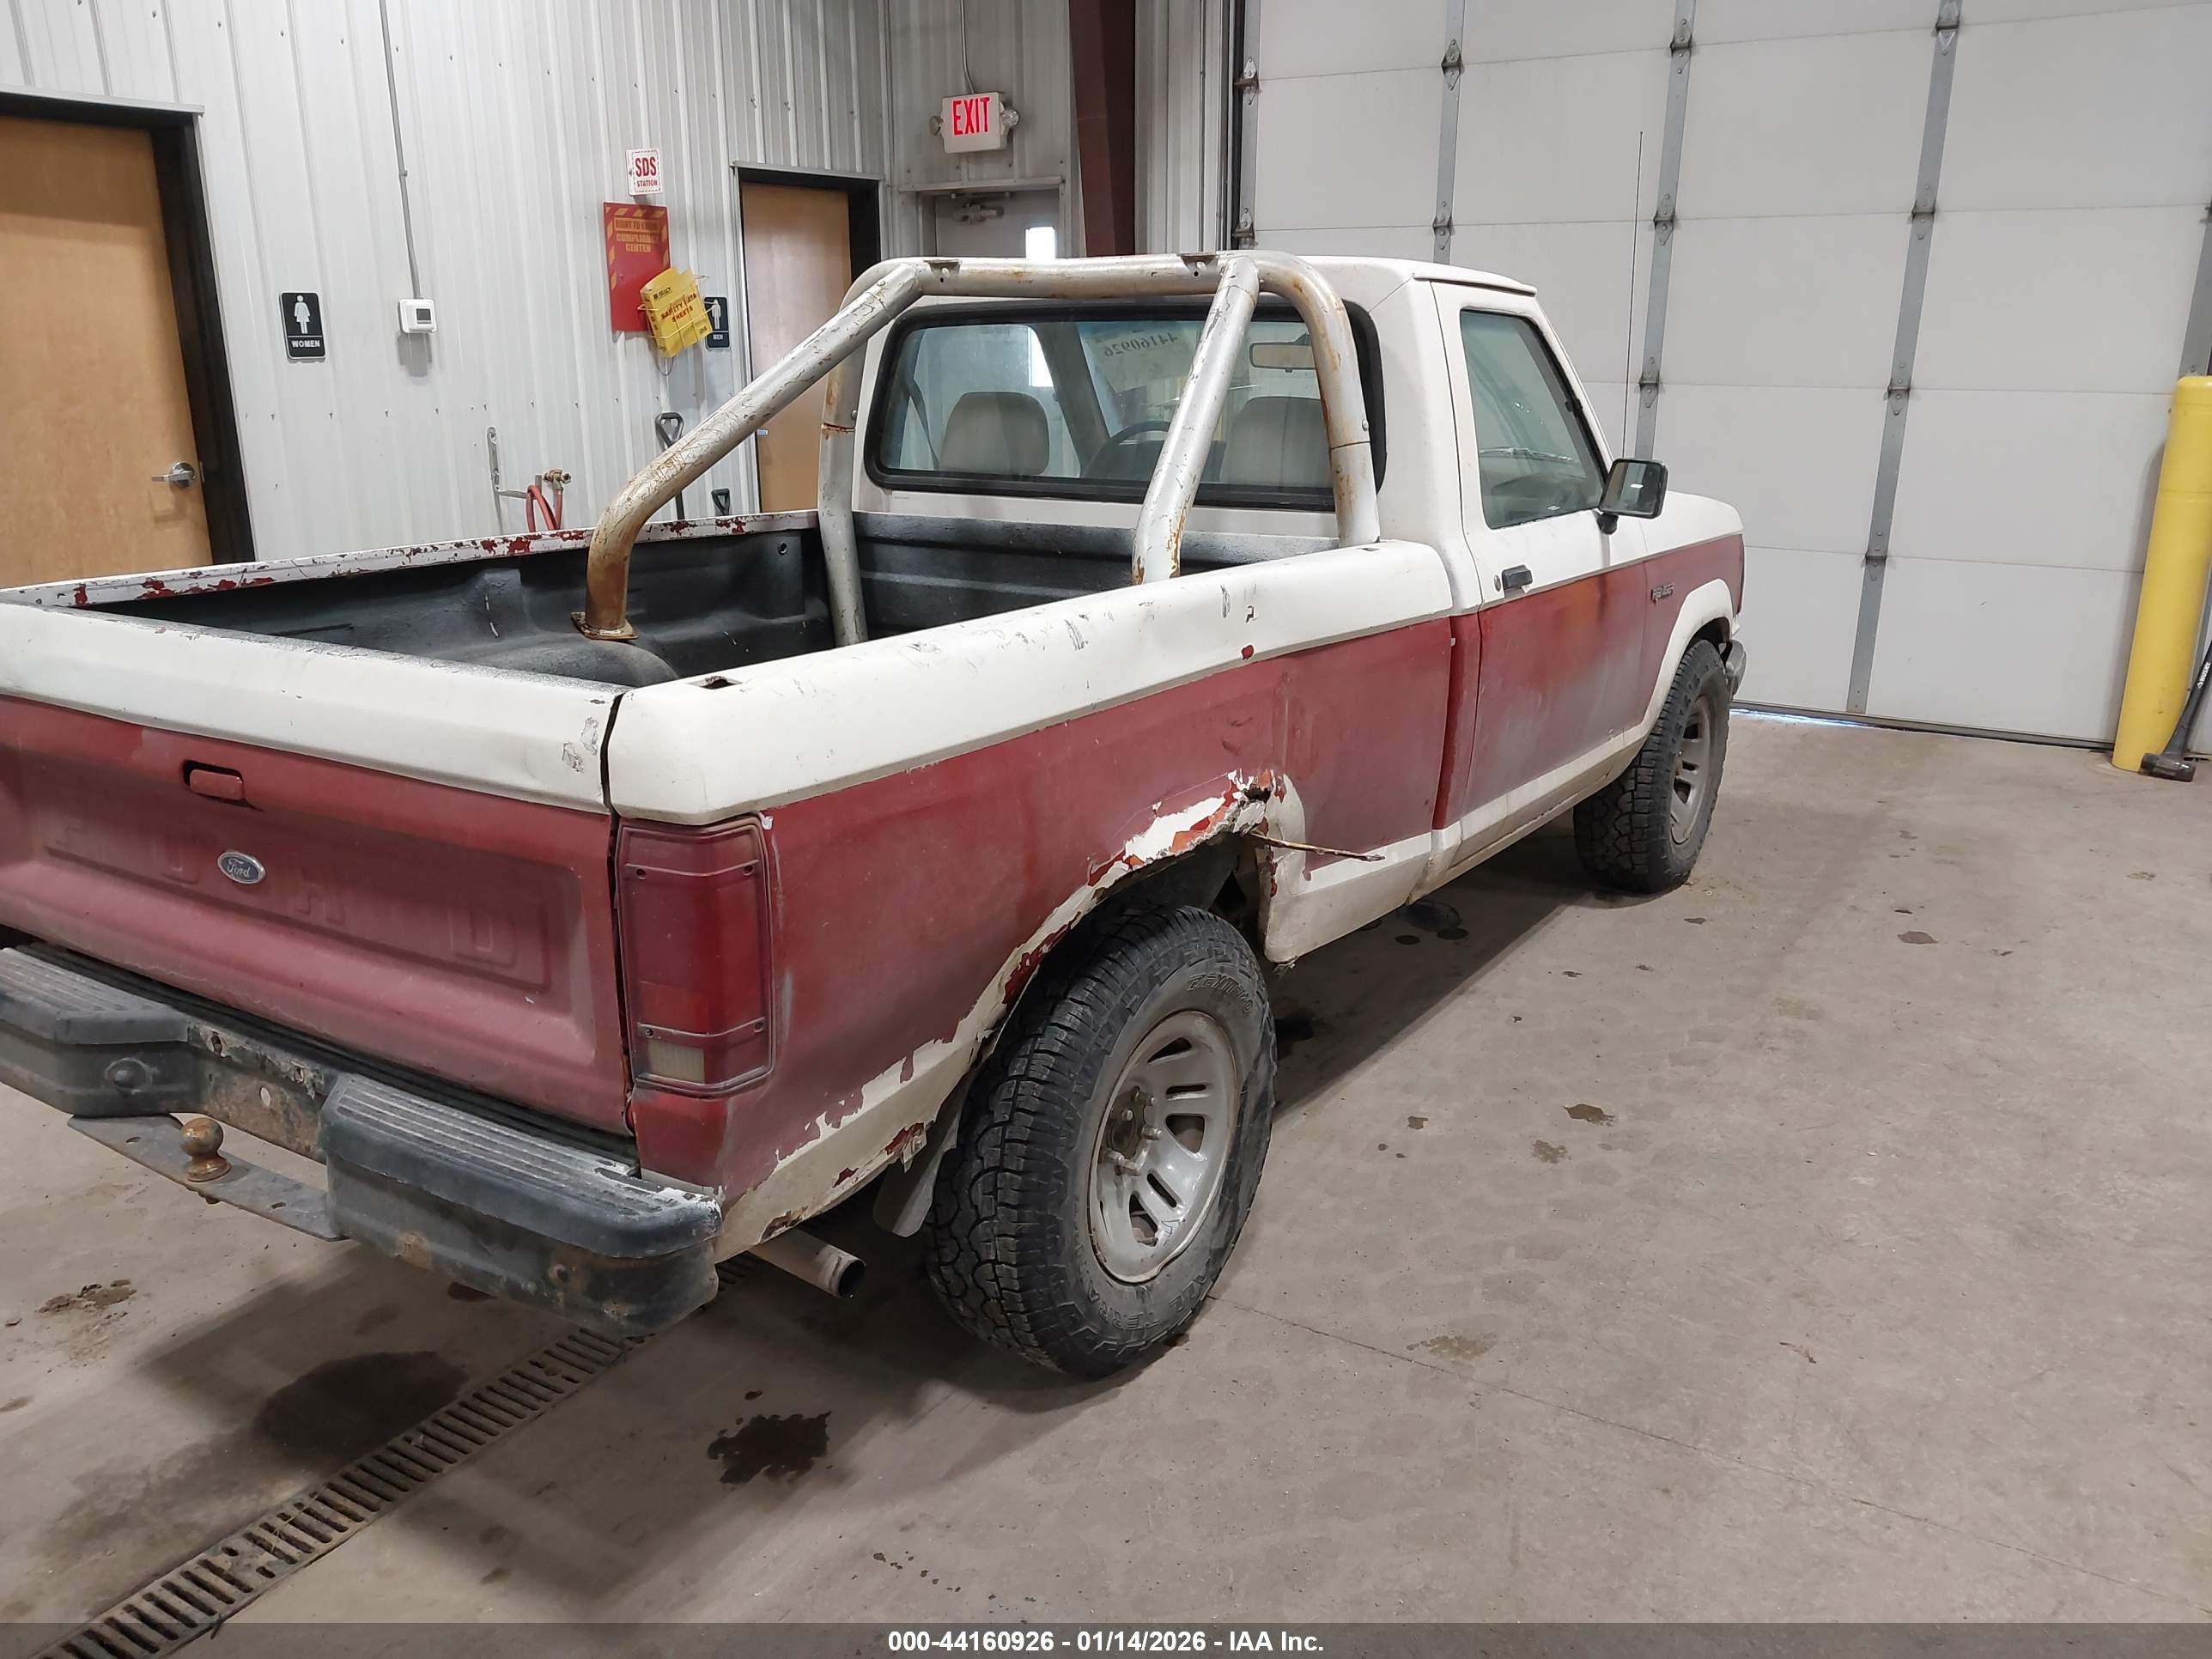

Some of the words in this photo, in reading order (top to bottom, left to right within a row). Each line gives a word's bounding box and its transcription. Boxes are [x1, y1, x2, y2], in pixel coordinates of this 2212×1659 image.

[953, 97, 990, 136] EXIT
[635, 156, 657, 178] SDS
[227, 857, 252, 878] Ford
